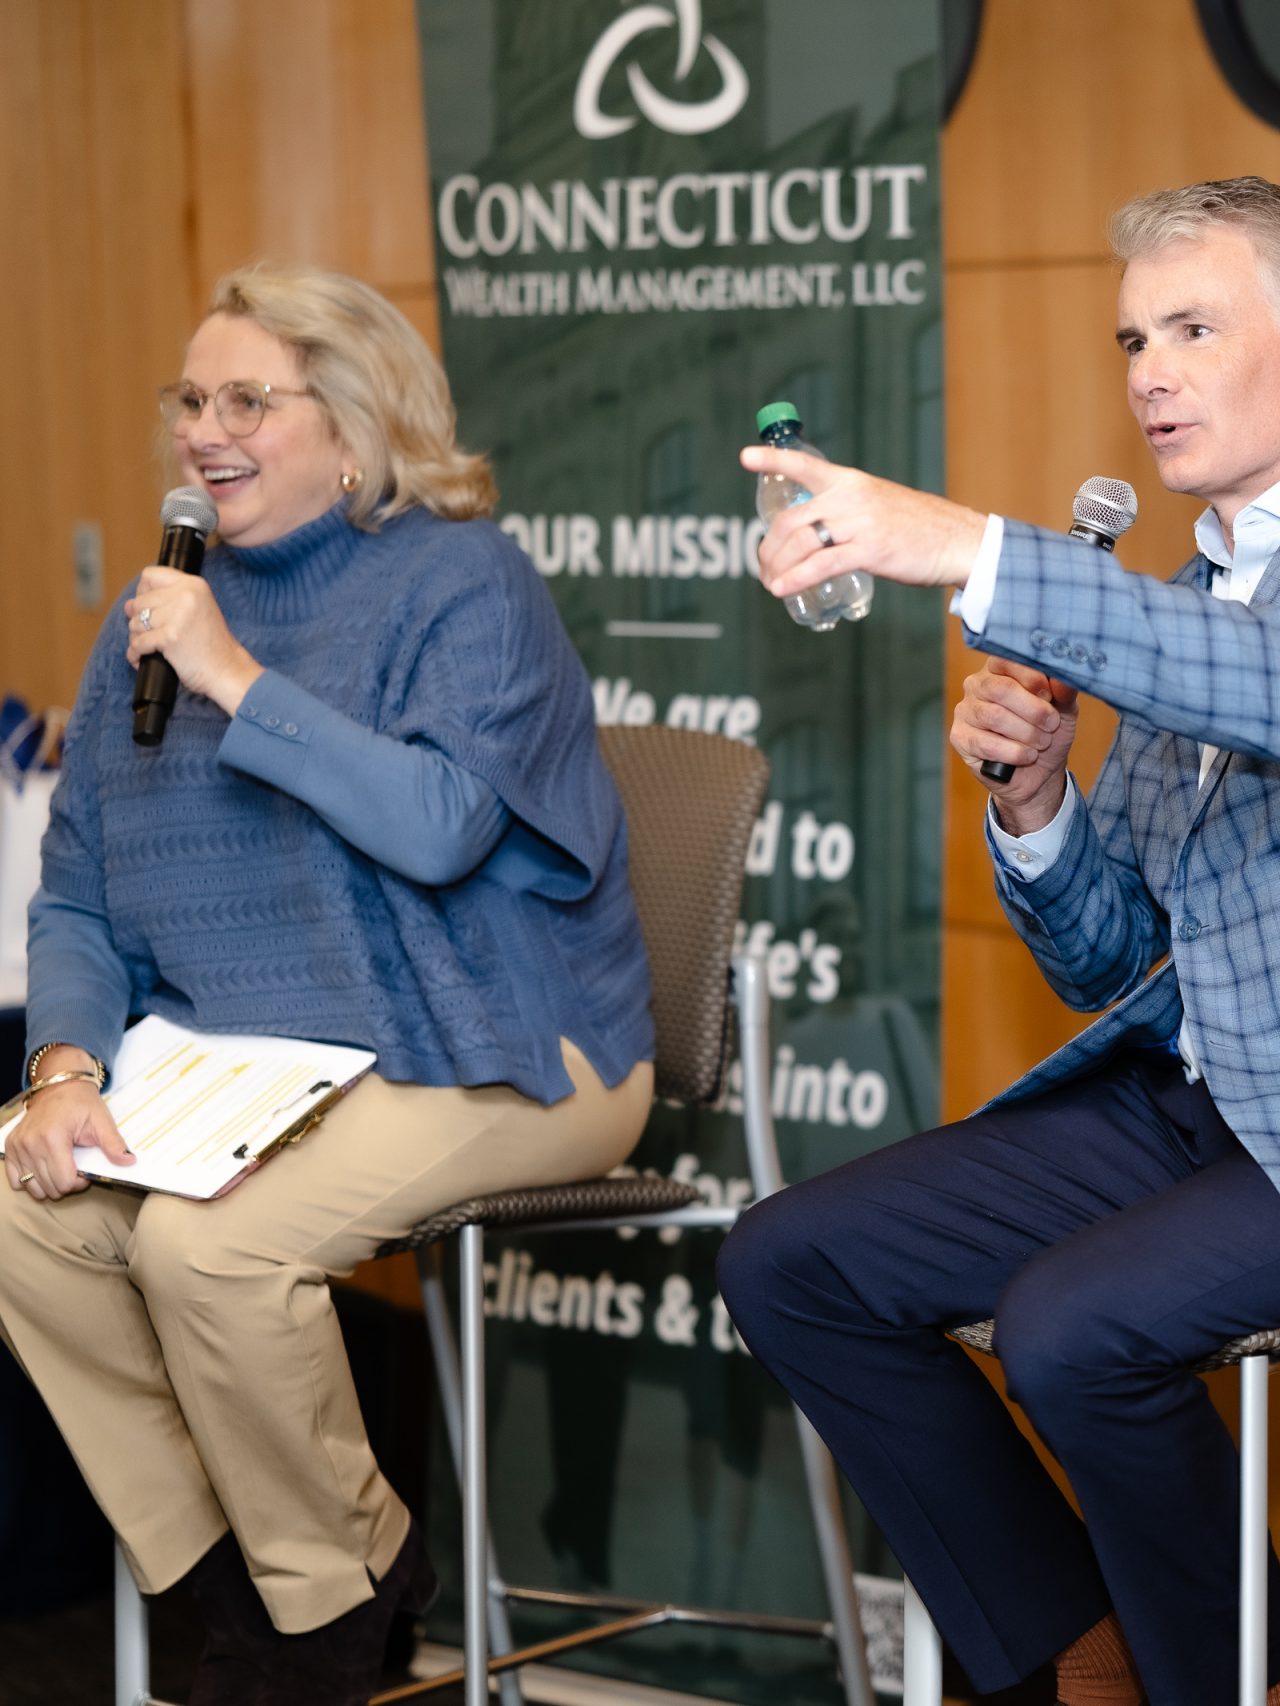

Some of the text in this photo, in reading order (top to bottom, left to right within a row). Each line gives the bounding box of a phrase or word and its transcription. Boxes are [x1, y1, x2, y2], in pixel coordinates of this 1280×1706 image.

[438, 164, 927, 259] CONNECTICUT
[443, 264, 572, 318] WEALTH
[851, 258, 926, 306] LLC
[791, 810, 855, 882] to
[771, 1043, 889, 1130] into
[654, 1272, 699, 1346] &
